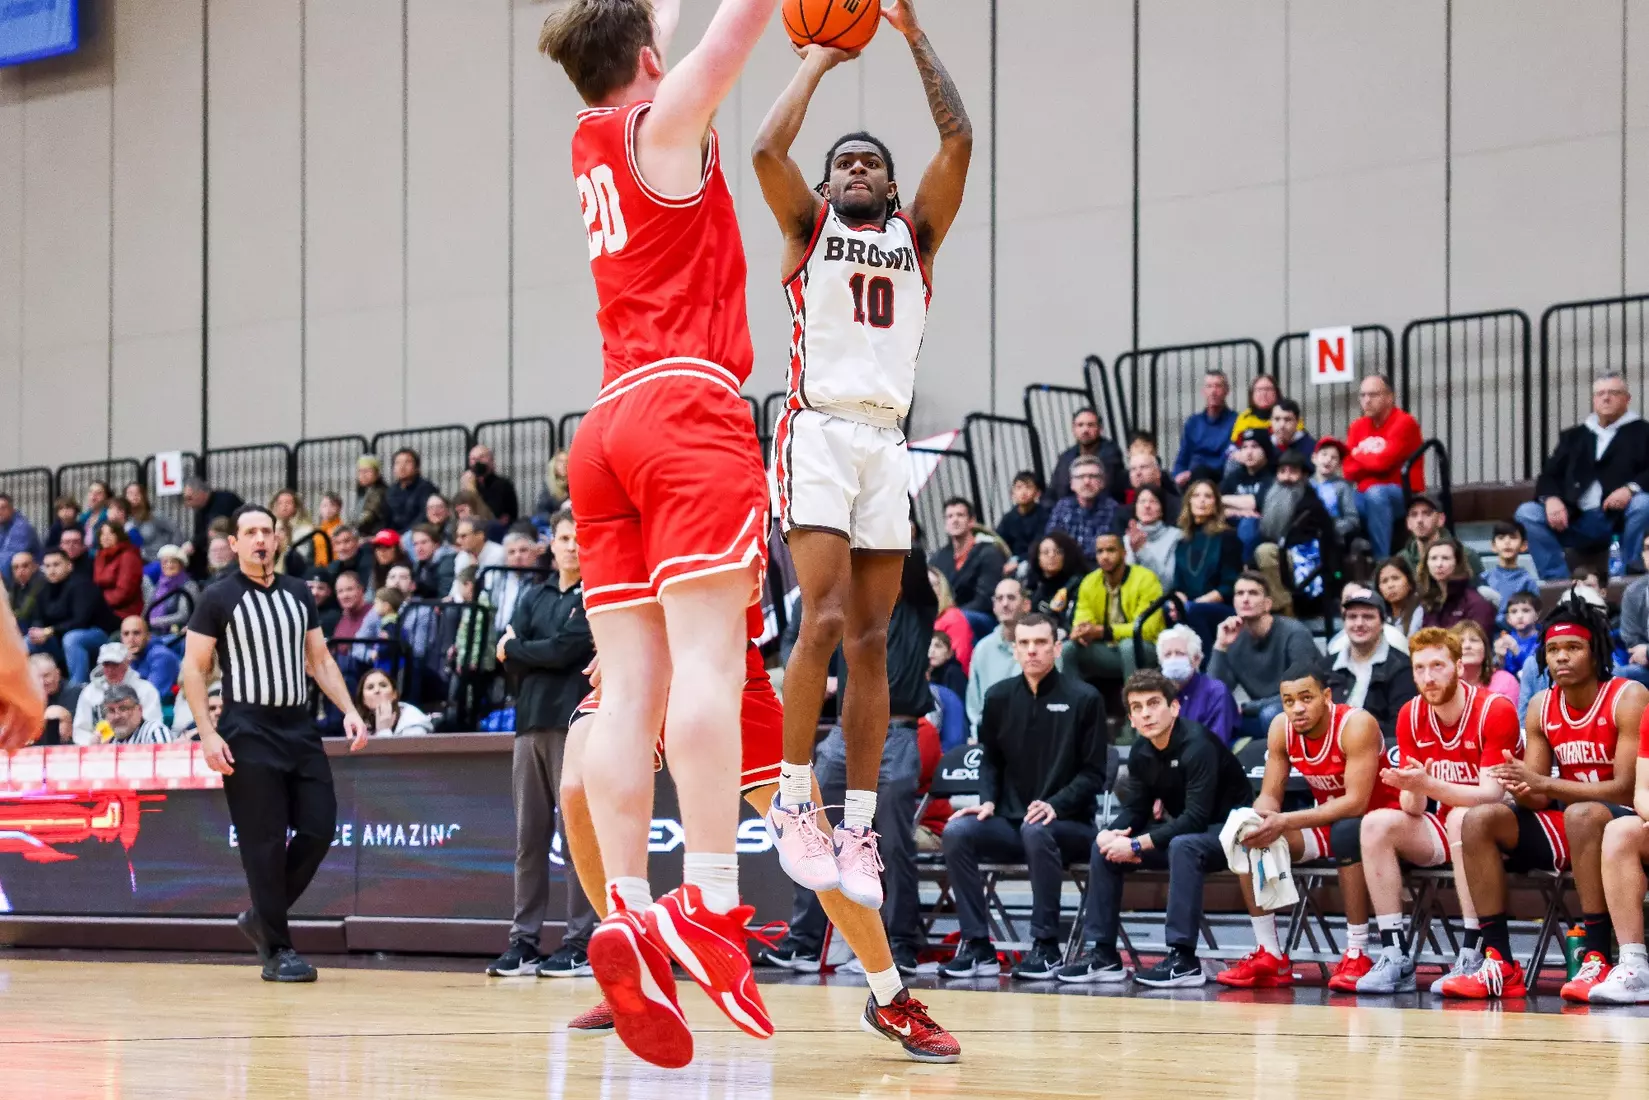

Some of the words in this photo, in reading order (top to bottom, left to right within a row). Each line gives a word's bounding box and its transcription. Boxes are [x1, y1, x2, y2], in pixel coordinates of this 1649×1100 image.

[576, 164, 628, 261] 20
[824, 236, 915, 272] BROWN
[849, 272, 894, 328] 10
[1317, 337, 1344, 372] N
[162, 460, 174, 486] L
[1431, 759, 1480, 783] ORNELL
